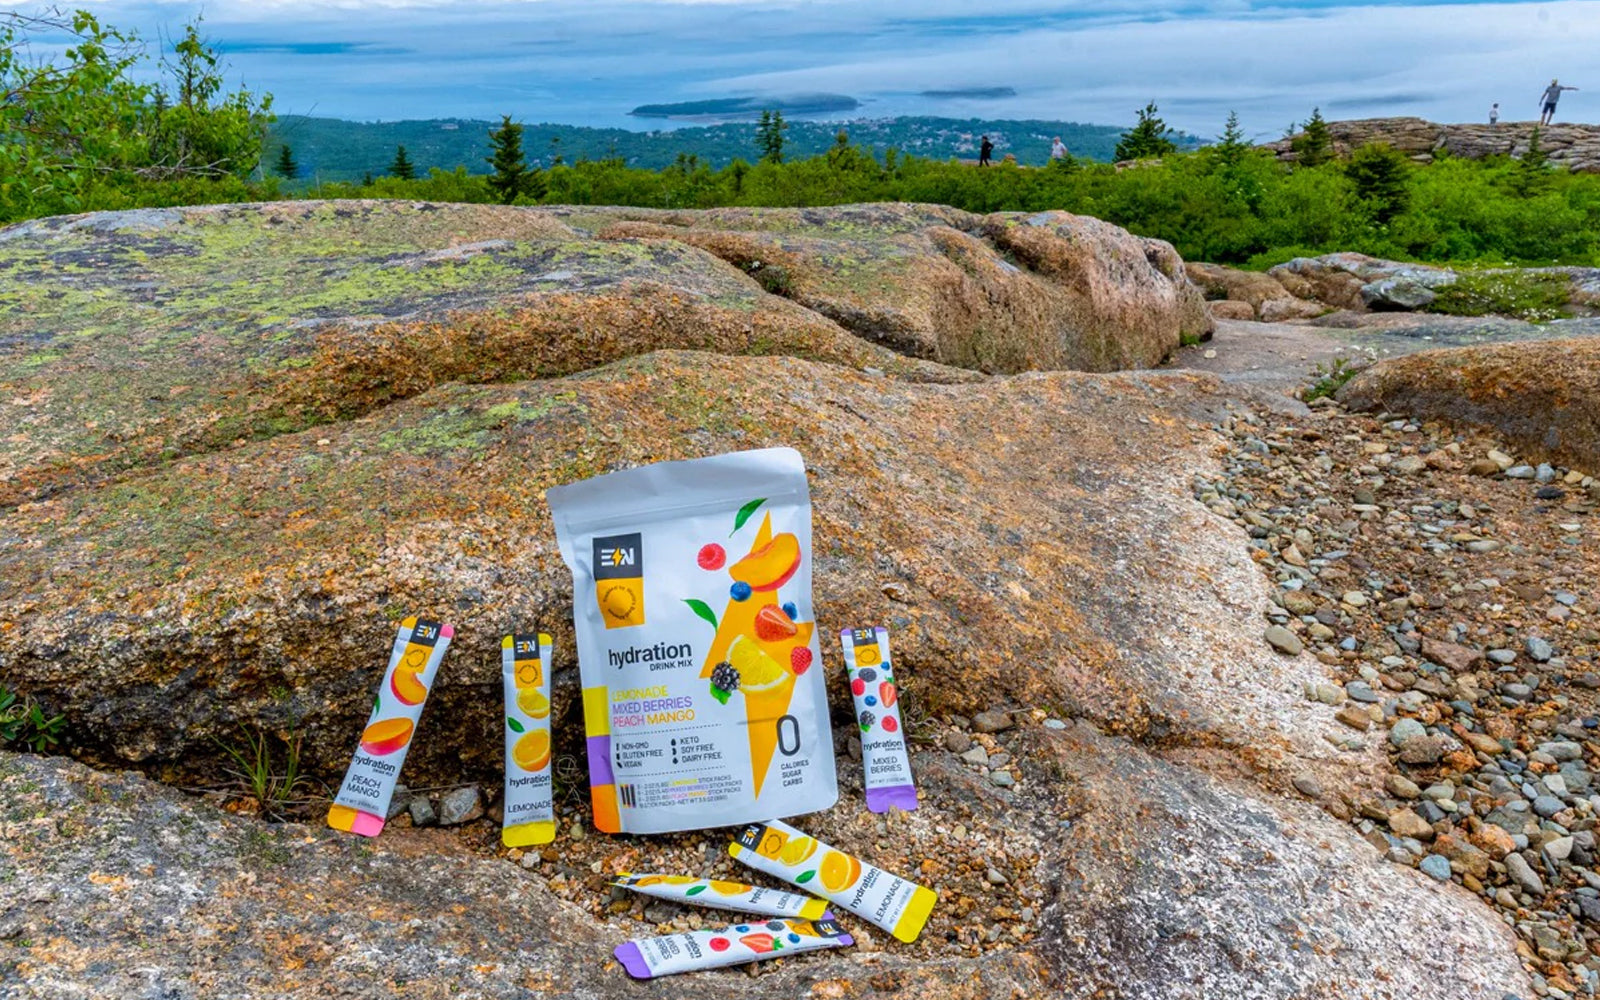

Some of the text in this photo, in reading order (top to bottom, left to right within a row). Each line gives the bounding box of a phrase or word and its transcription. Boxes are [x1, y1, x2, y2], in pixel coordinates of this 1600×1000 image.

[608, 642, 692, 670] hydration
[649, 659, 693, 672] DRINK MIX
[611, 685, 668, 702] LEMONADE
[612, 695, 693, 715] MIXED BERRIES
[612, 709, 695, 728] PEACH MANGO
[621, 741, 649, 751] NON-GMO
[680, 736, 699, 745] KETO
[863, 739, 903, 751] hydration
[622, 749, 664, 760] GLUTEN FREE
[681, 743, 715, 755] SOY FREE
[681, 751, 722, 764] DAIRY FREE
[872, 756, 898, 765] MIXED
[623, 760, 642, 769] VEGAN
[780, 759, 810, 770] CALORIES
[870, 763, 902, 775] BERRIES
[782, 769, 802, 779] SUGAR
[351, 774, 382, 789] PEACH
[509, 774, 550, 788] hydration
[782, 777, 803, 788] CARBS
[346, 782, 381, 798] MANGO
[507, 799, 552, 814] LEMONADE
[850, 867, 879, 909] hydration
[874, 877, 904, 923] LEMONADE
